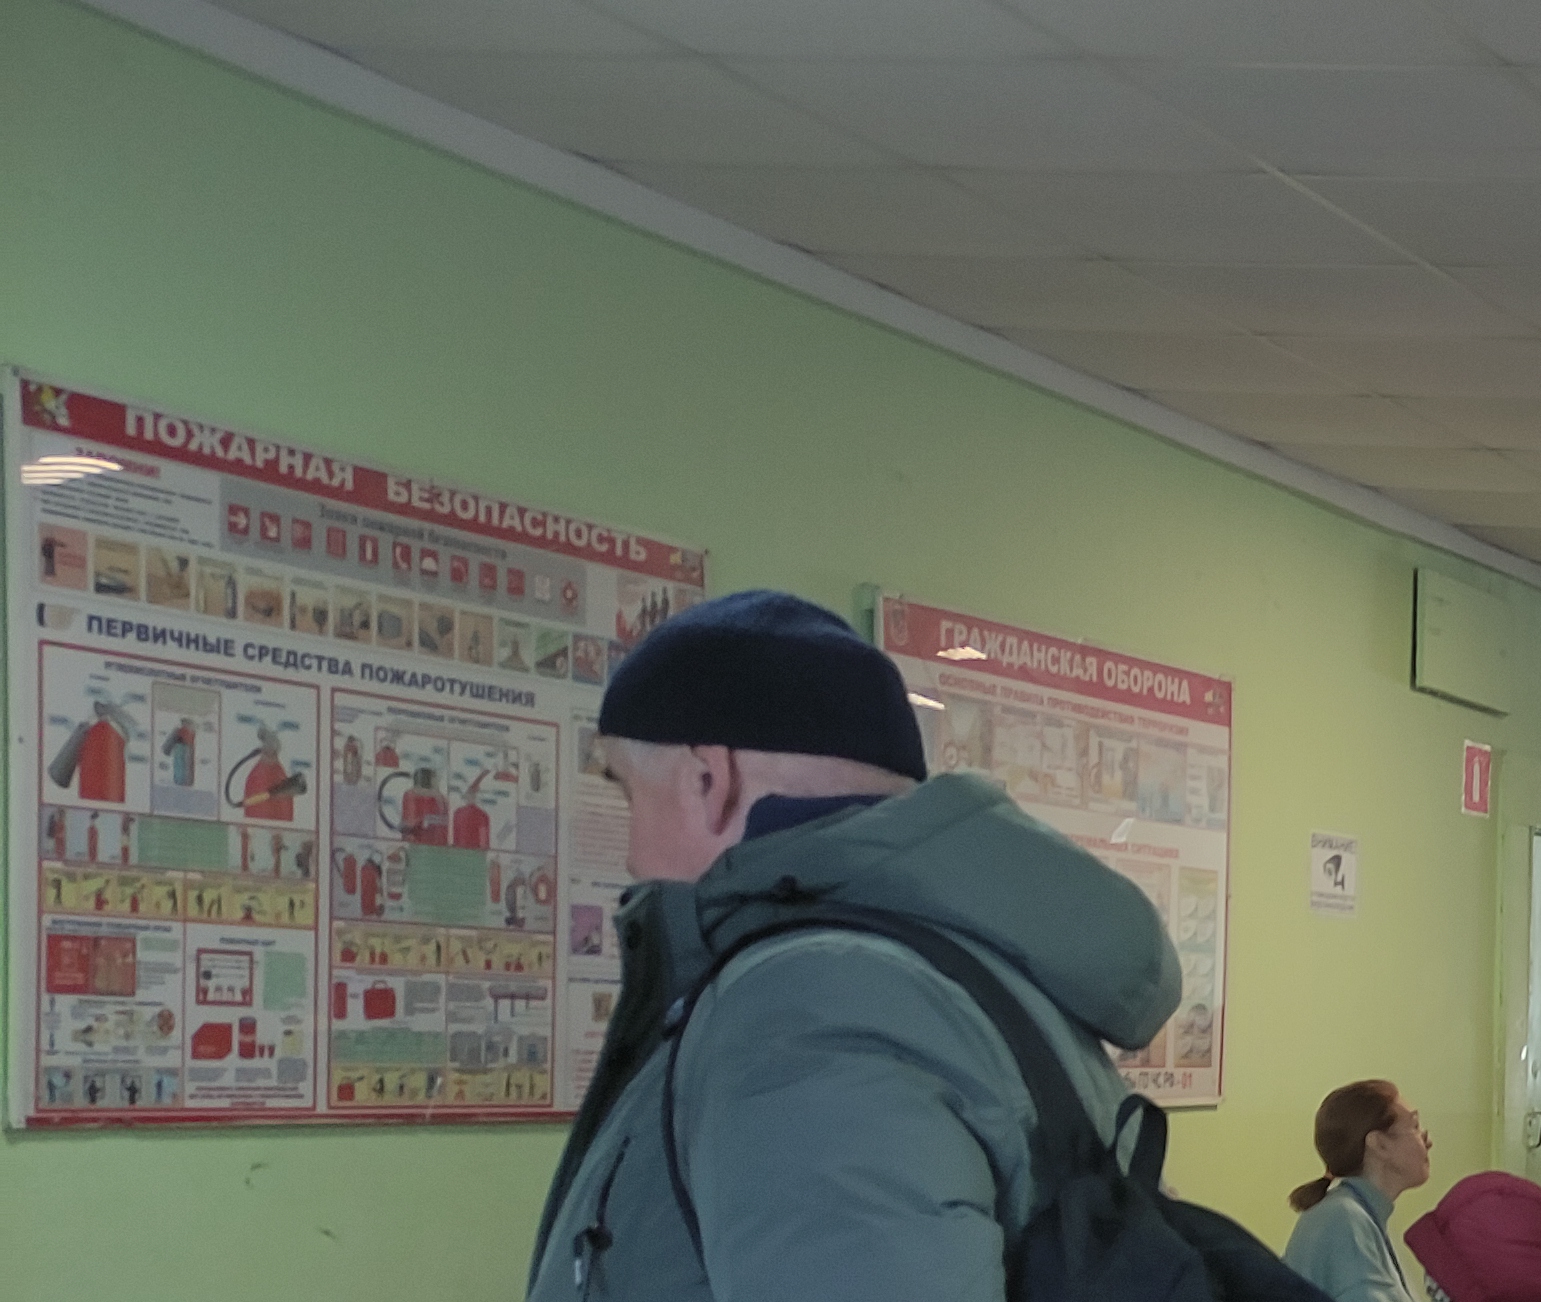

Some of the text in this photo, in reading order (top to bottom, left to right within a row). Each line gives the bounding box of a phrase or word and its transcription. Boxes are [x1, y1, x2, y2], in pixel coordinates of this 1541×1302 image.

[124, 405, 648, 562] ПОЖАРНАЯ БЕЗОПАСНОСТЬ
[87, 614, 536, 708] ПЕРВИЧНЫЕ СРЕДСТВА ПОЖАРОТУШЕНИЯ
[939, 619, 1191, 705] ГРАЖДАНСКАЯ ОБОРОНА
